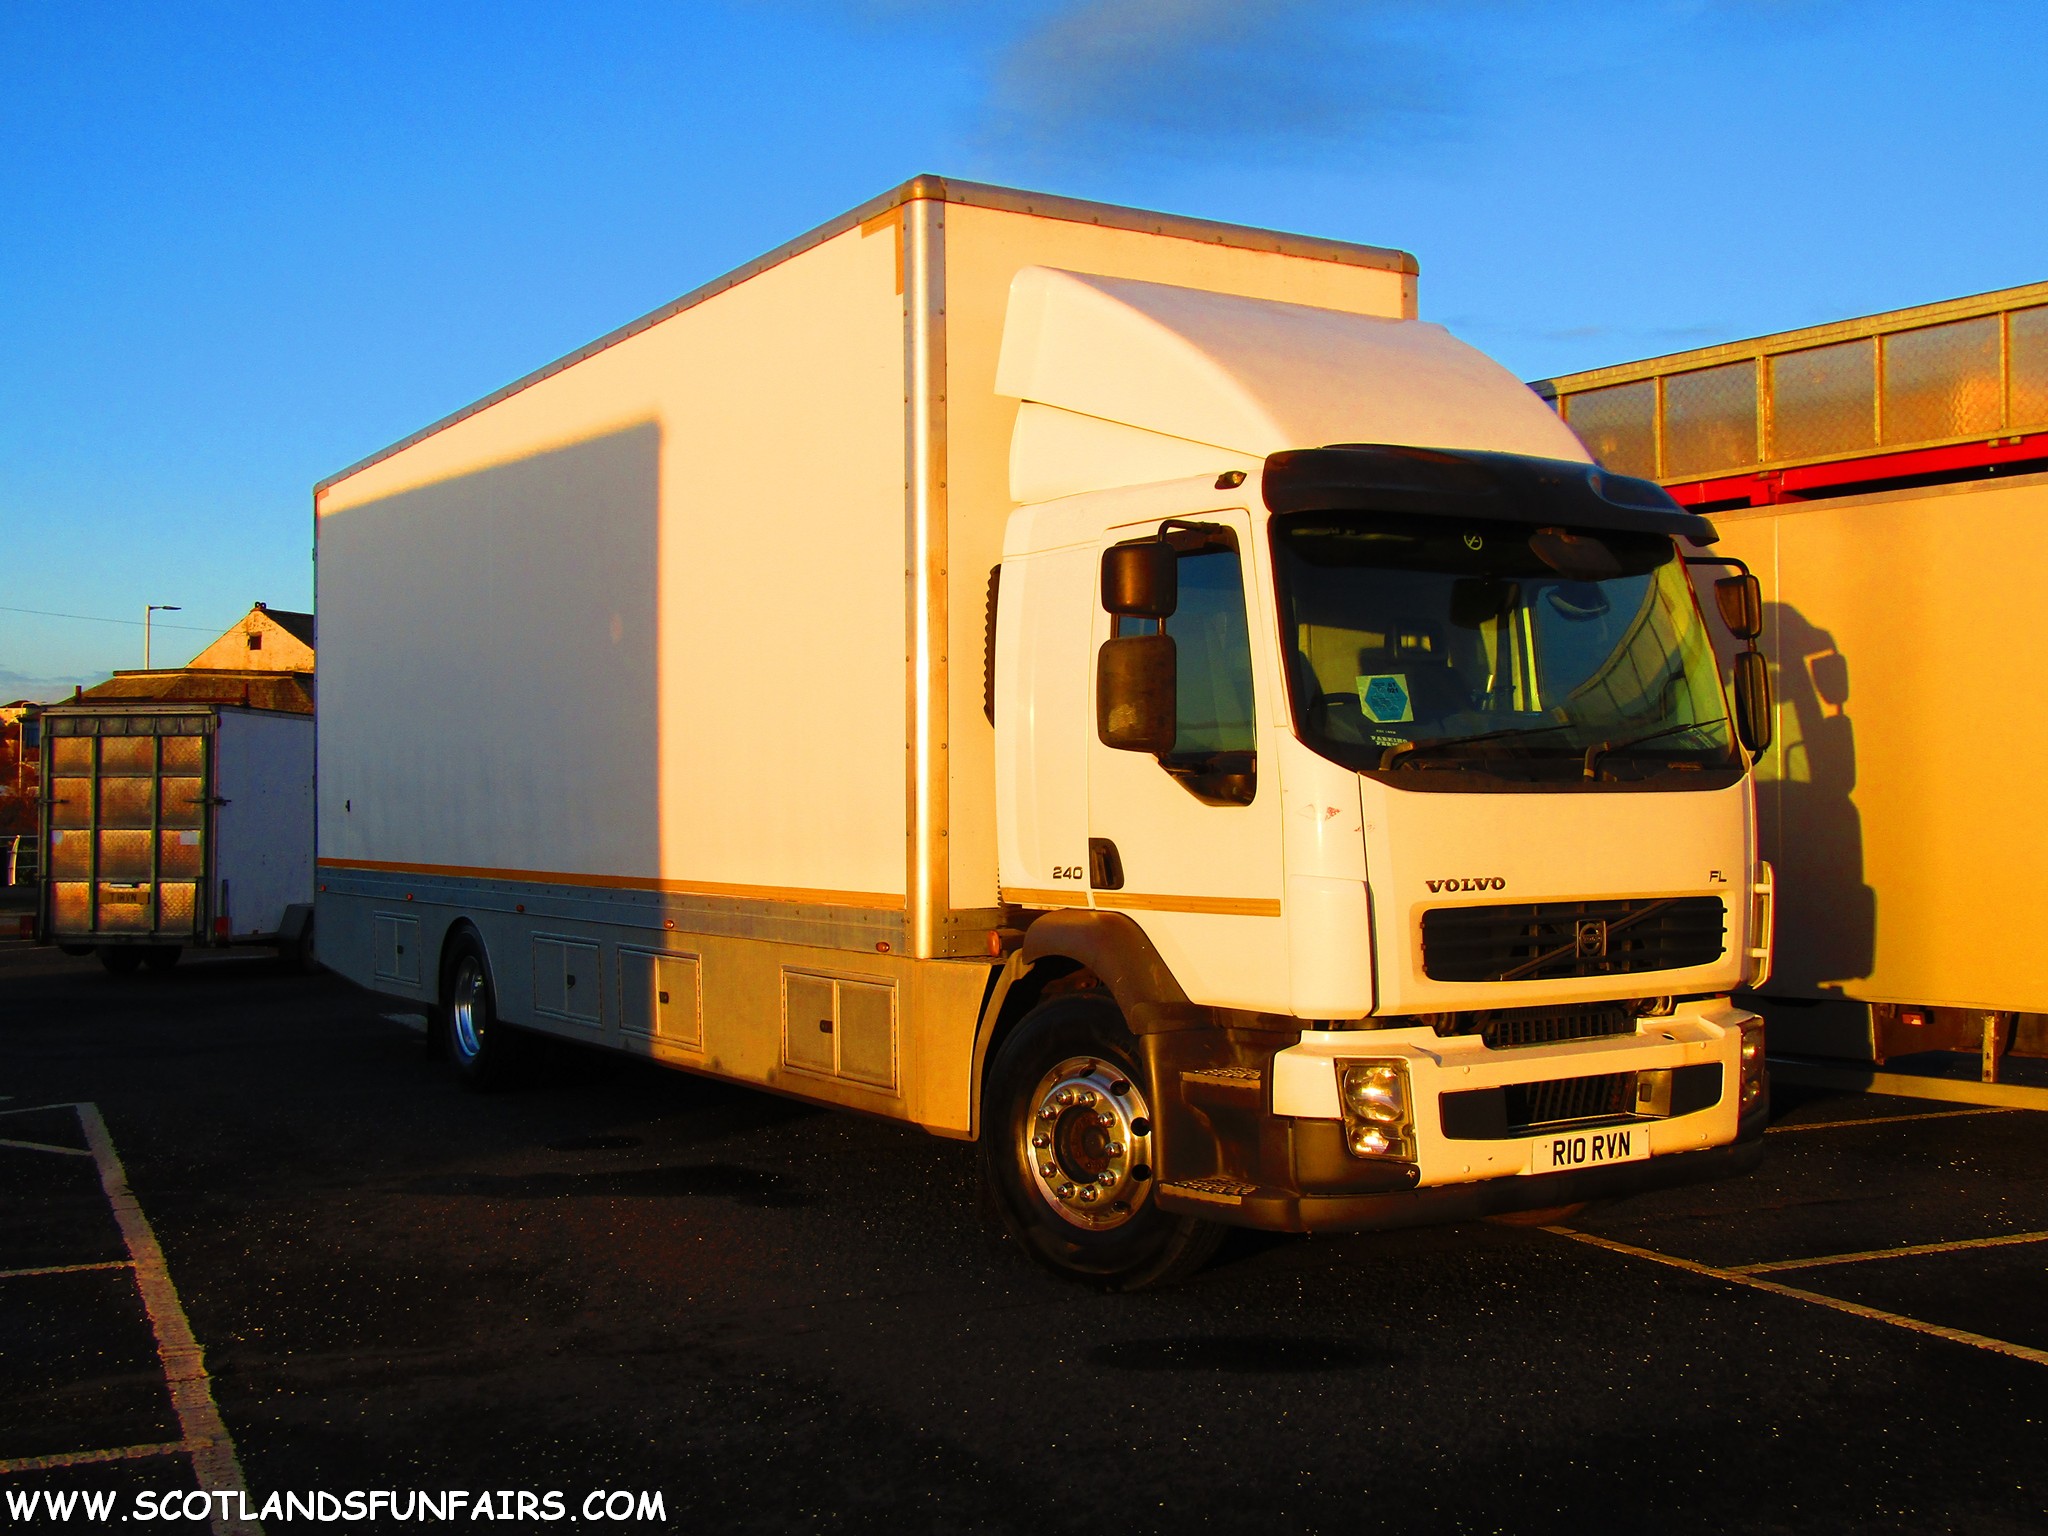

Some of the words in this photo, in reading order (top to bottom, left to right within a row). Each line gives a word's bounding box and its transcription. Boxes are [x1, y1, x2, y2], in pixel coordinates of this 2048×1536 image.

[1052, 866, 1083, 880] 240
[1709, 870, 1727, 882] FL
[1425, 877, 1505, 893] VOLVO
[1553, 1138, 1586, 1167] R10
[1592, 1131, 1631, 1162] RVN
